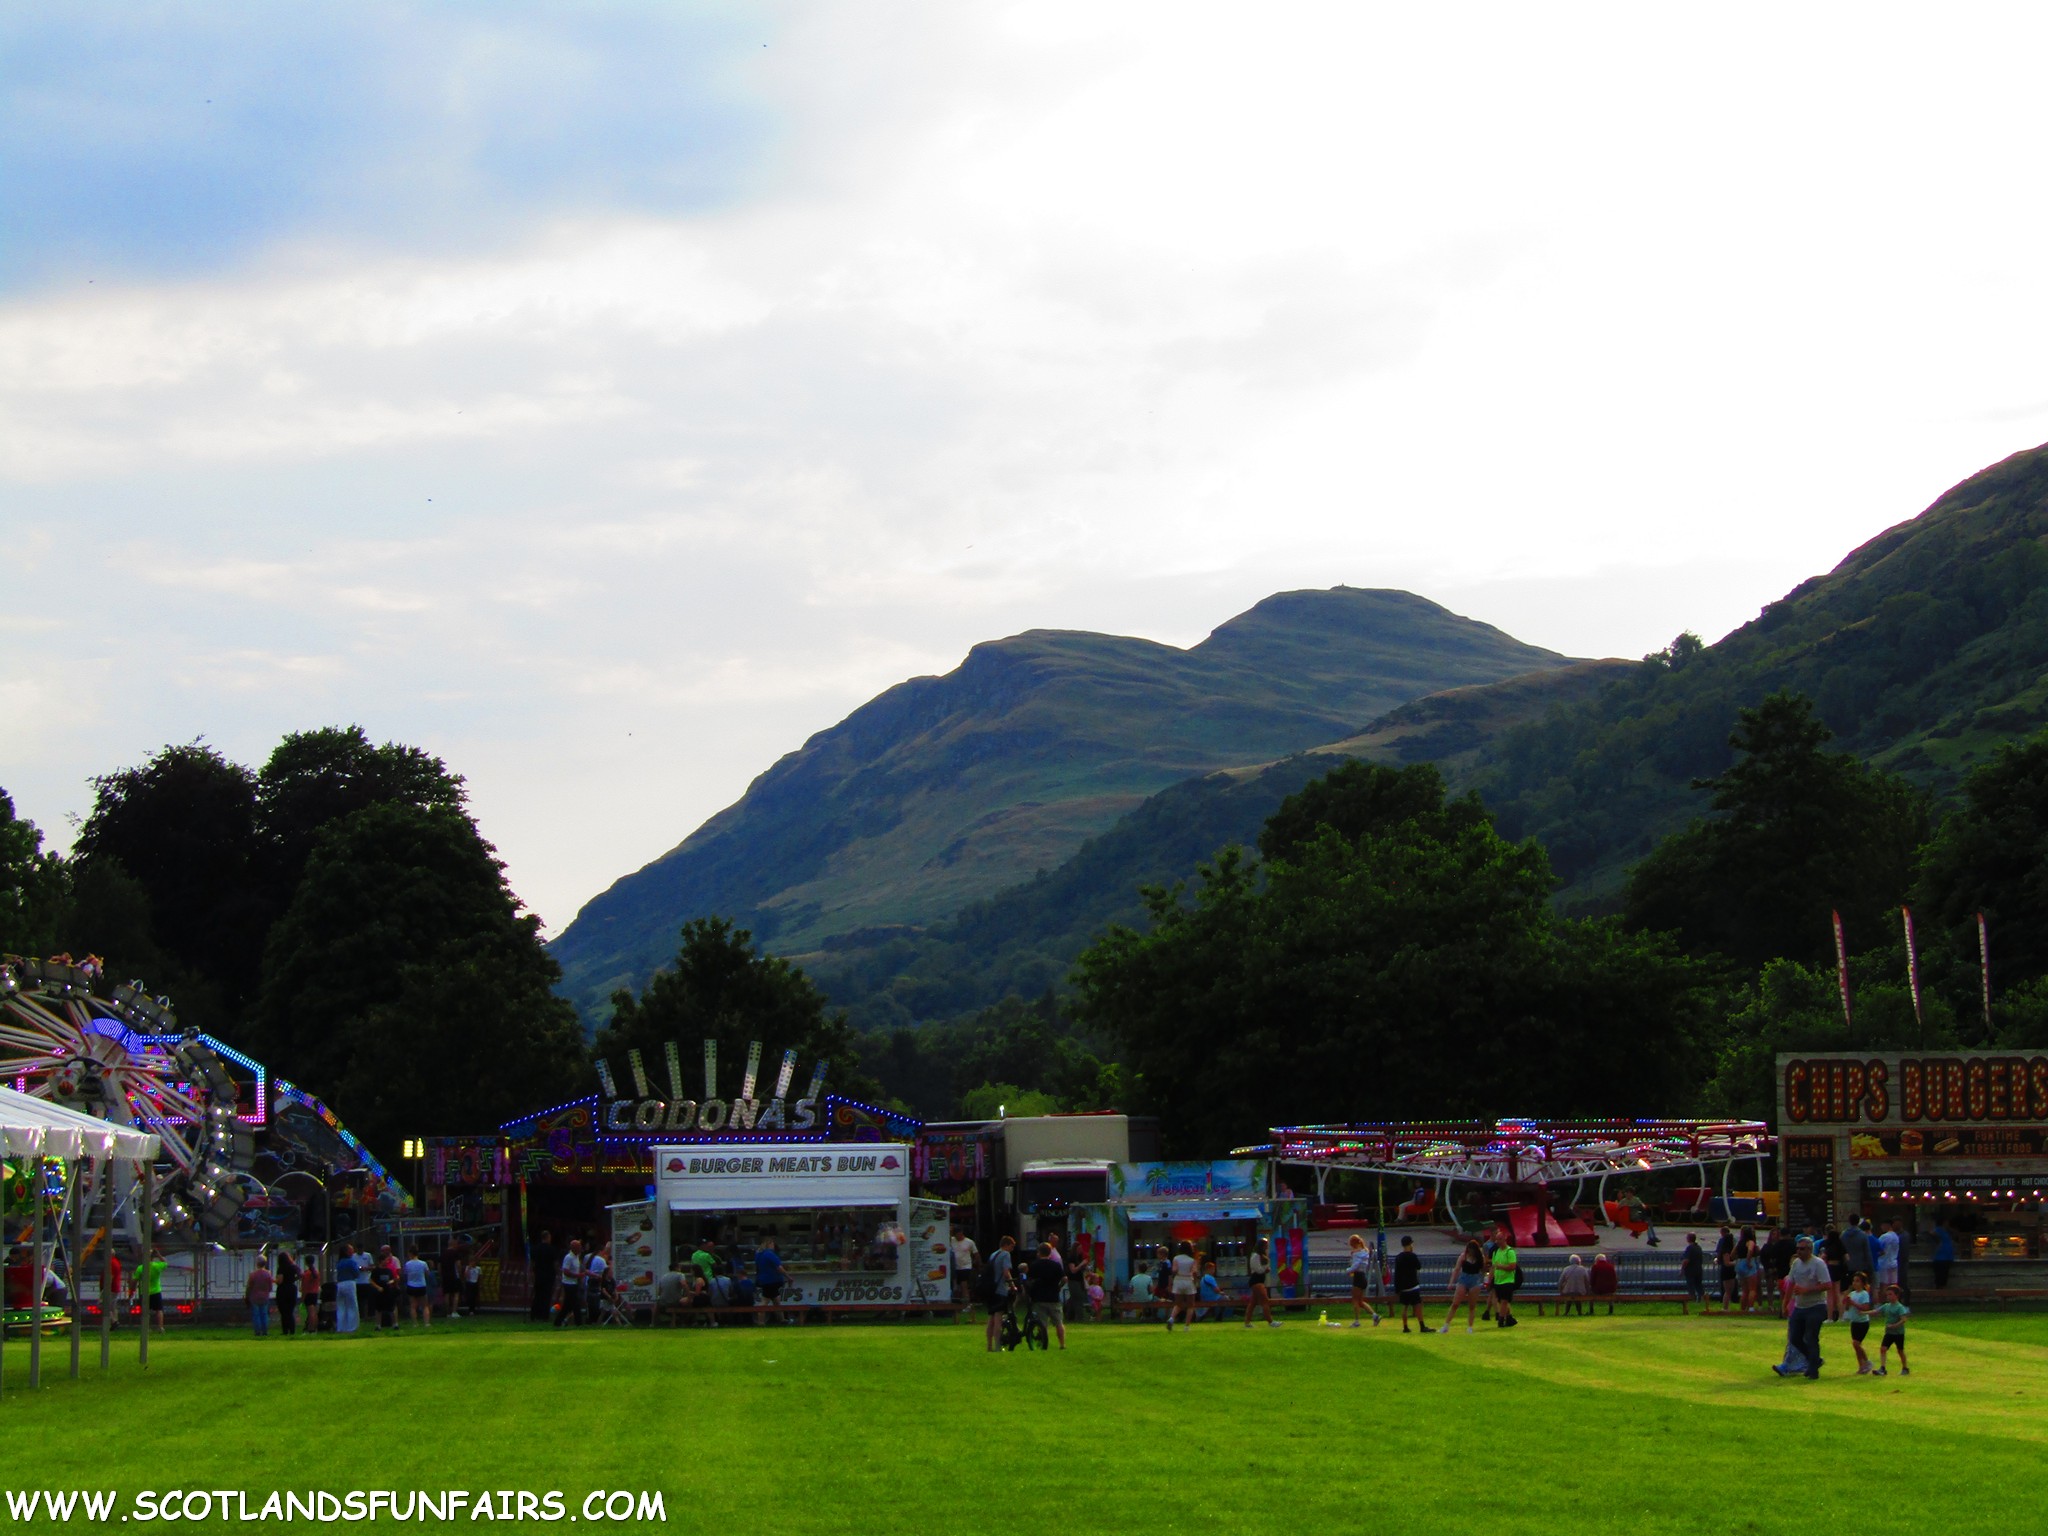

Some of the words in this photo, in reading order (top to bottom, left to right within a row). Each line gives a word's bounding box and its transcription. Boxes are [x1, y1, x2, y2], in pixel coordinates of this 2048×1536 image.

[1786, 1060, 1888, 1121] CHIPS
[1901, 1058, 2048, 1121] BURGERS
[607, 1098, 817, 1132] CODONAS
[1974, 1131, 2020, 1141] FUNTIME
[1789, 1143, 1828, 1158] MENU
[1964, 1143, 2003, 1153] STREET
[2006, 1142, 2032, 1153] FOOD
[689, 1157, 764, 1174] BURGER
[768, 1156, 832, 1173] MEATS
[837, 1155, 877, 1172] BUN
[1867, 1179, 1882, 1188] COLD
[1911, 1179, 1932, 1187] COFFEE
[1938, 1178, 1950, 1187] TEA
[1955, 1178, 1992, 1187] CAPPUCCINO
[1998, 1177, 2015, 1186] LATTE
[2021, 1177, 2033, 1185] HOT
[835, 1278, 885, 1288] AWESOME
[754, 1287, 804, 1302] CIPS
[817, 1286, 903, 1302] HOTDOGS
